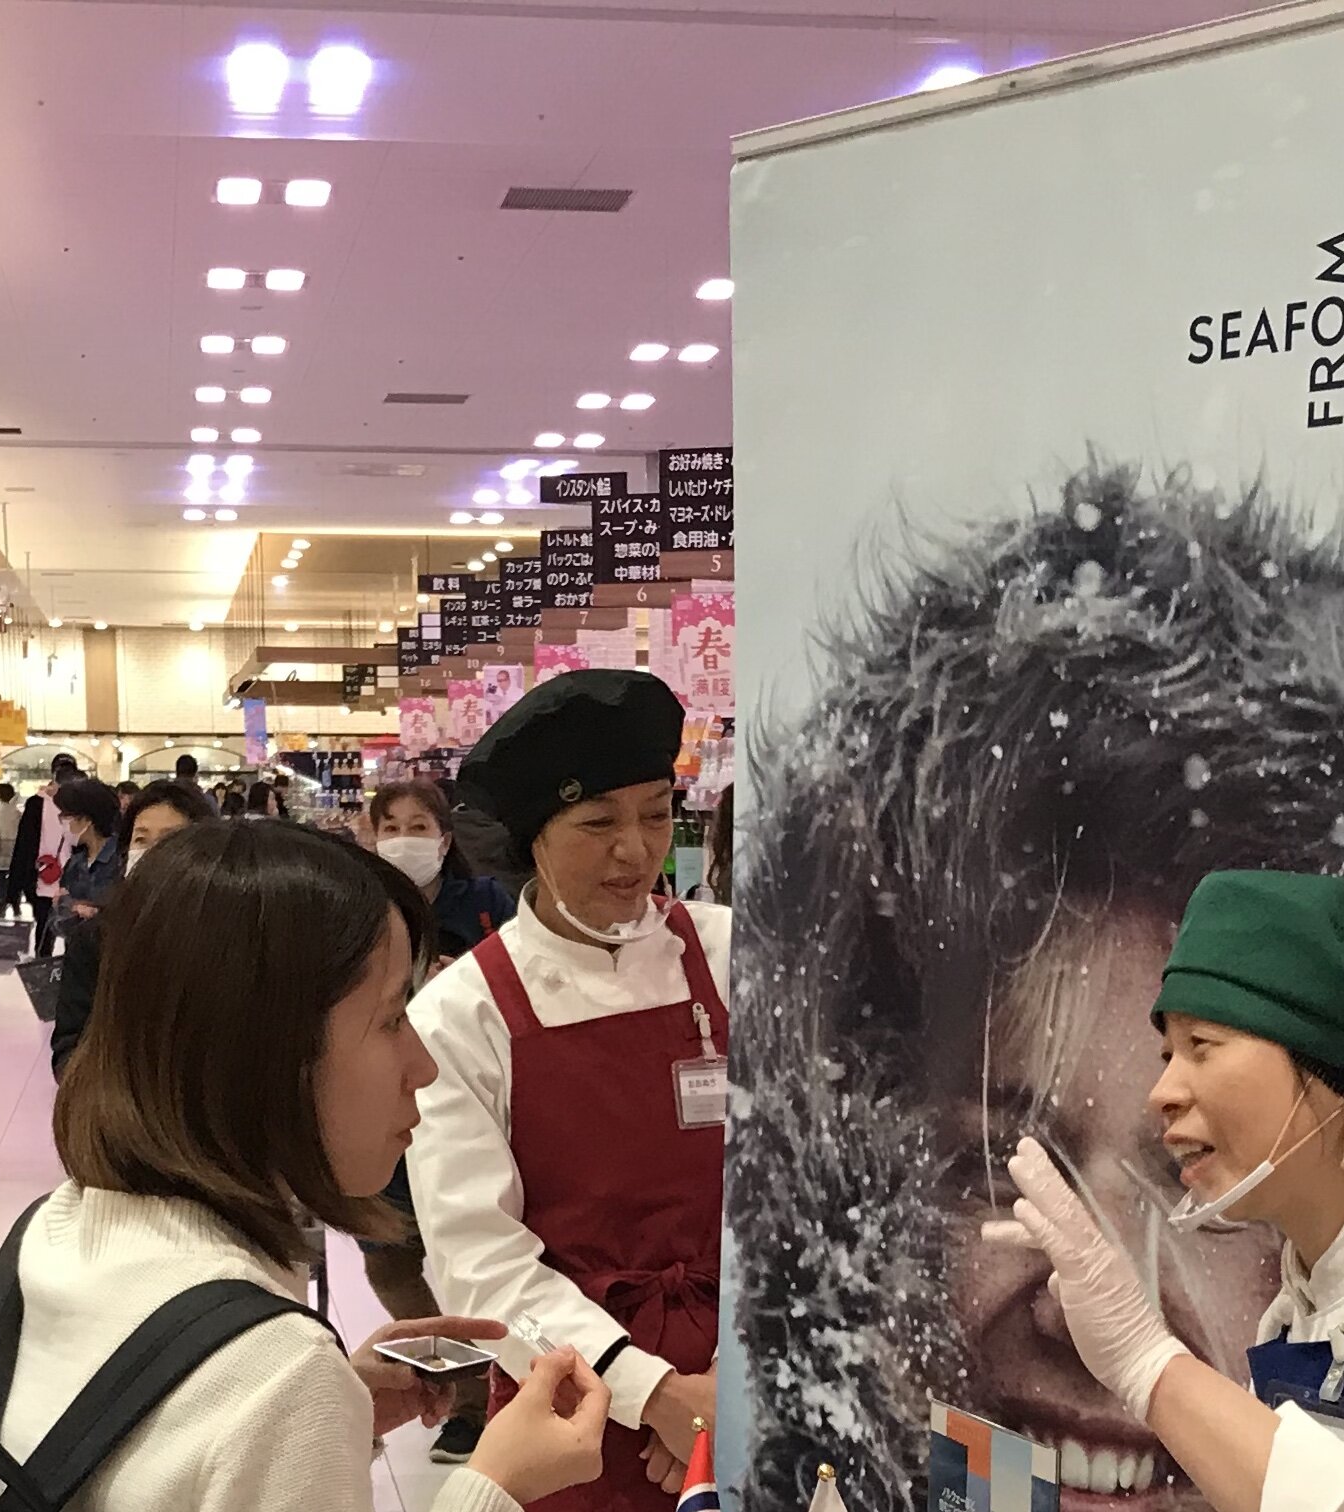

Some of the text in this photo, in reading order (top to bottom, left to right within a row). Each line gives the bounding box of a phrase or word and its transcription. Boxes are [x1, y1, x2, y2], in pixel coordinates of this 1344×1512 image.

[668, 452, 734, 472] お好み焼き・
[669, 504, 734, 523] マヨネーズ・ドレ
[600, 518, 661, 537] スープ・み
[711, 554, 721, 572] 5
[636, 586, 647, 602] 6
[579, 611, 589, 625] 7
[535, 629, 544, 641] 8
[497, 645, 505, 657] 9
[691, 627, 731, 671] 春
[467, 658, 480, 669] 10
